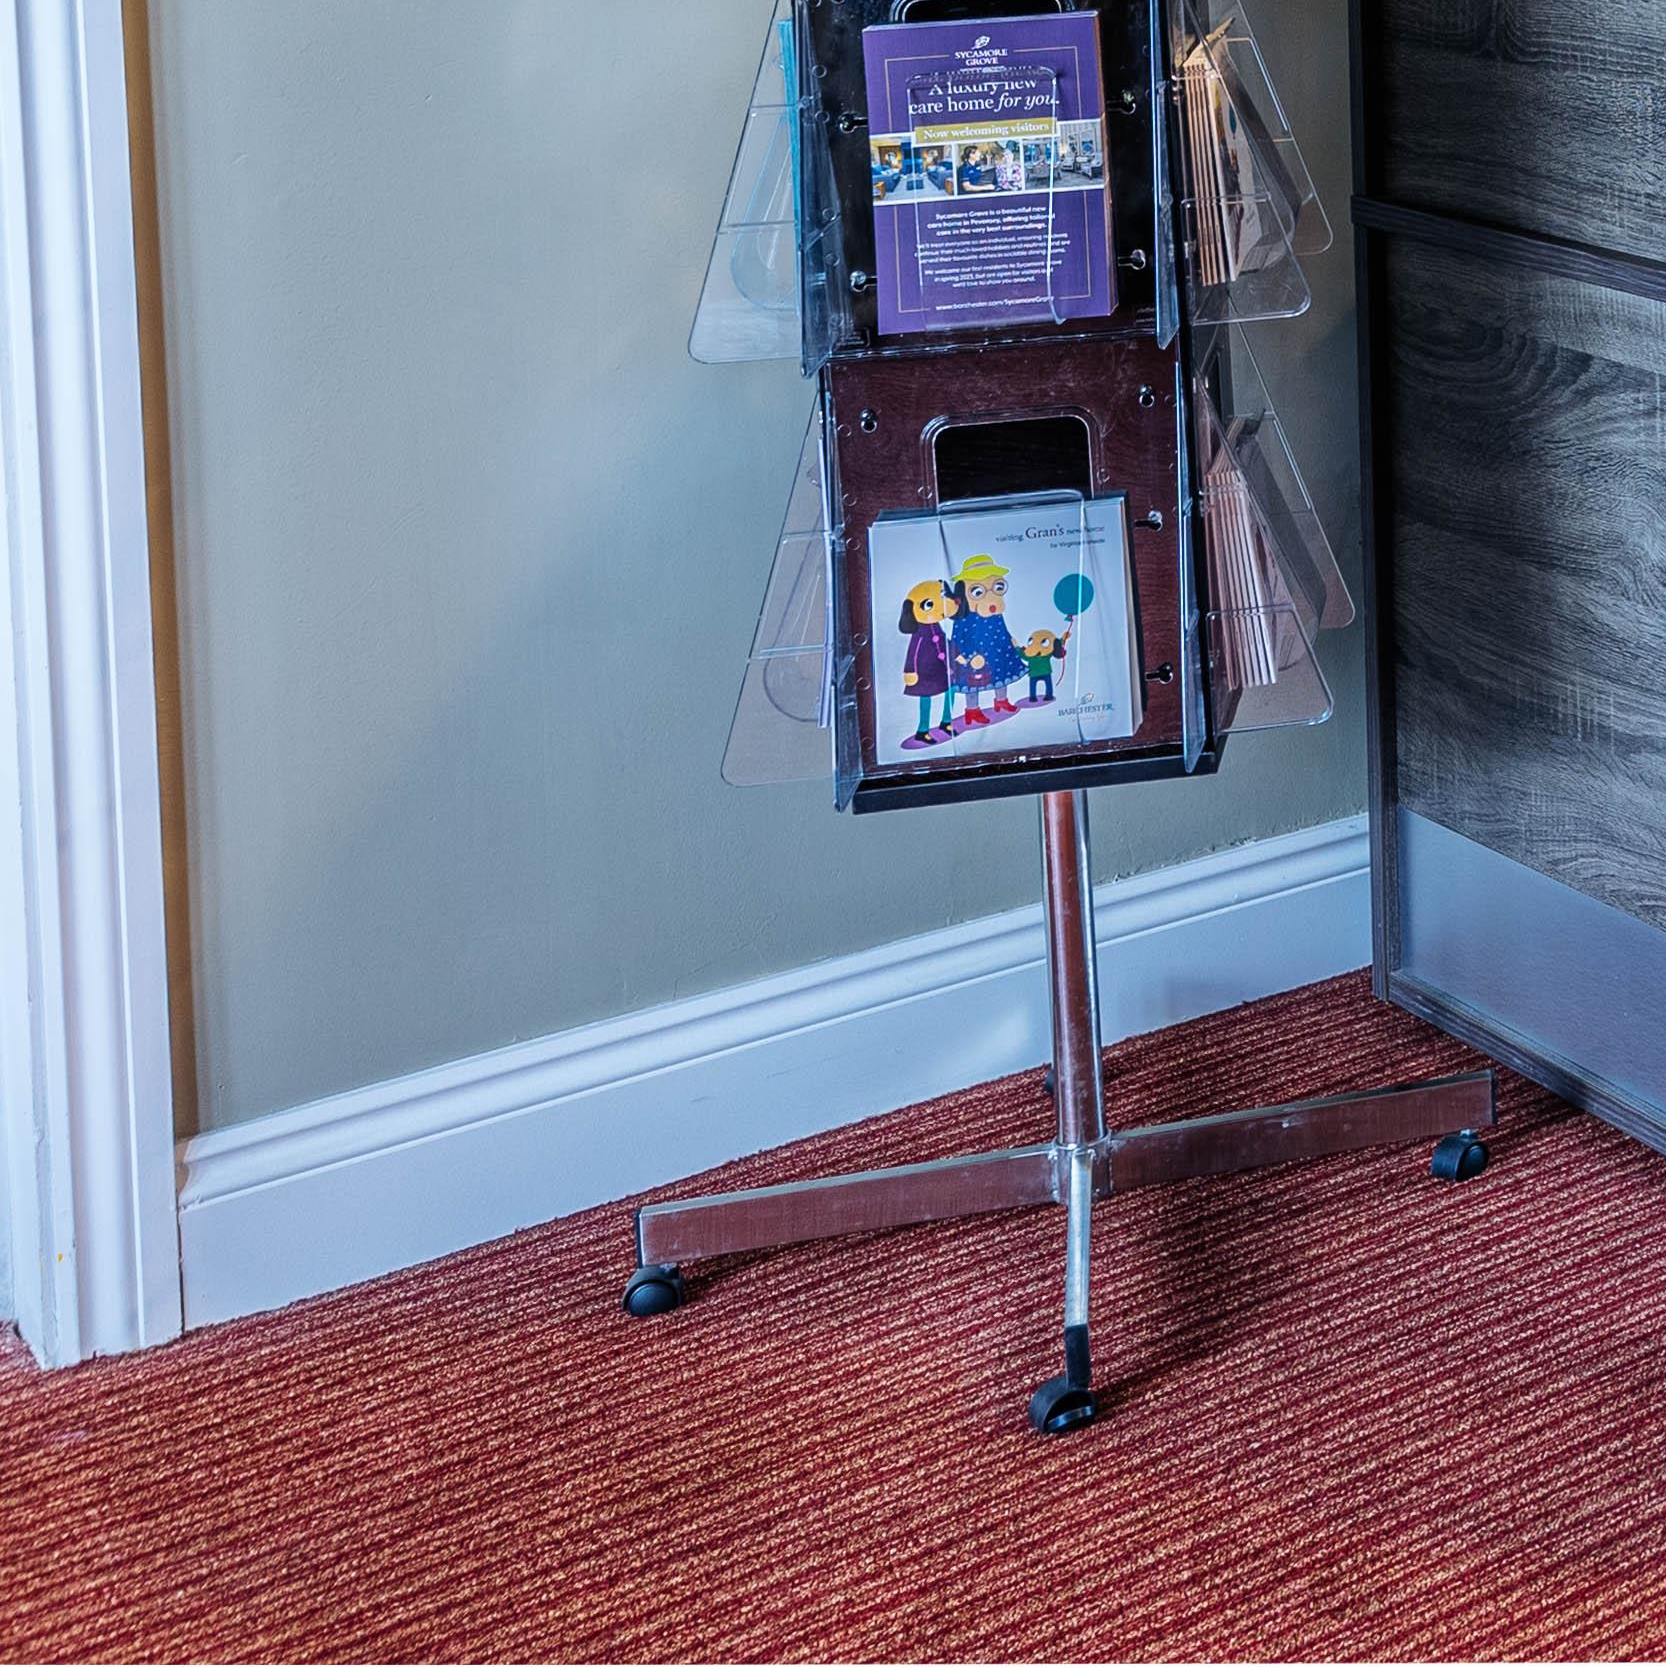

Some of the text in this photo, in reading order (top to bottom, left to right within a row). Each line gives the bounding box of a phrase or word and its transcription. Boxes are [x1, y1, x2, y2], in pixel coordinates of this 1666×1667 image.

[955, 49, 1008, 59] SYCAMORE
[966, 57, 999, 66] GROVE
[947, 81, 998, 95] luxury
[910, 93, 1059, 114] care home for you.
[923, 122, 1048, 140] Now welcoming visitors
[1025, 523, 1064, 539] Gran's
